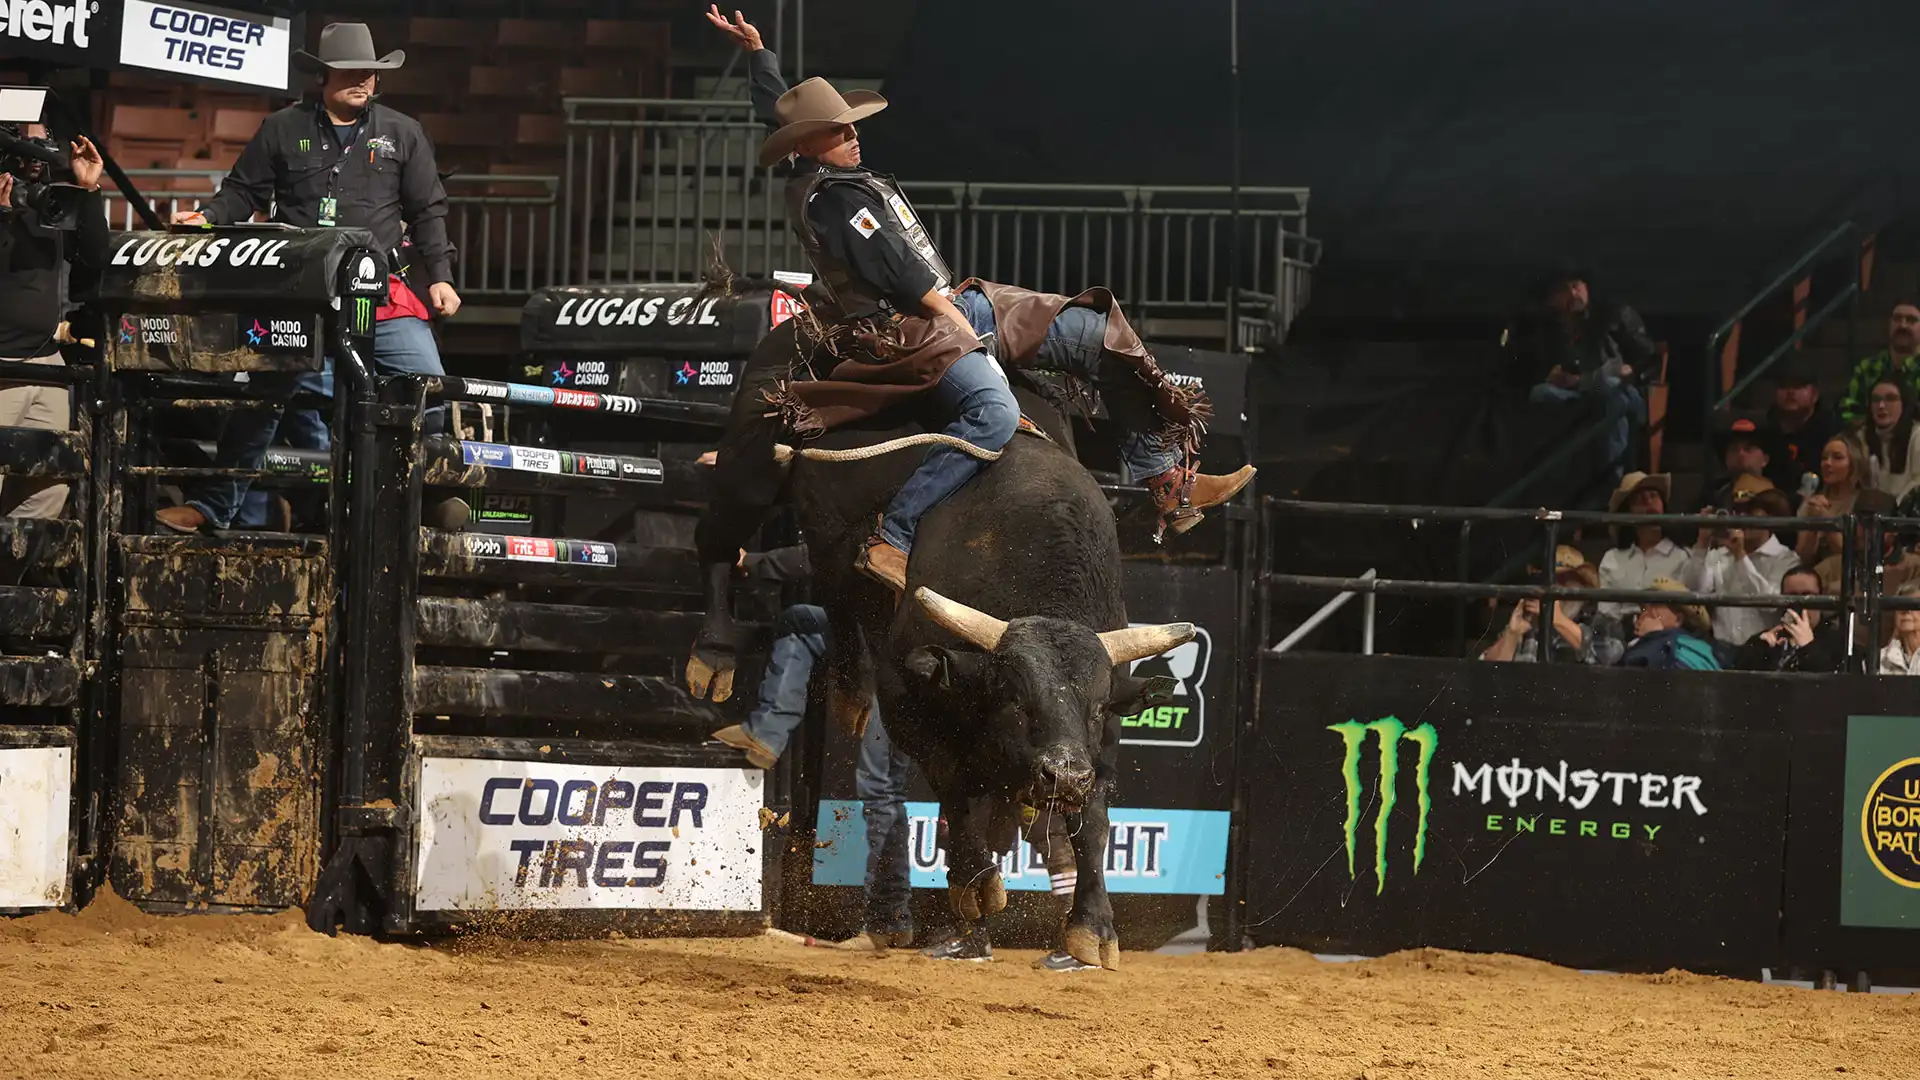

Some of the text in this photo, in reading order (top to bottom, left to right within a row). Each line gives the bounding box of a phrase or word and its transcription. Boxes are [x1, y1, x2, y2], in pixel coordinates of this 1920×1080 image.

[149, 7, 265, 47] COOPER
[164, 37, 246, 71] TIRES
[111, 238, 231, 267] LUCAS
[555, 297, 665, 326] LUCAS
[140, 318, 170, 331] MODO
[270, 320, 301, 334] MODO
[141, 331, 178, 344] CASINO
[271, 334, 308, 348] CASINO
[576, 361, 606, 373] MODO
[700, 361, 729, 373] MODO
[574, 373, 609, 386] CASINO
[698, 373, 733, 386] CASINO
[556, 392, 597, 407] LUCAS OIL
[601, 394, 637, 413] YETI
[515, 449, 554, 460] COOPER
[522, 459, 549, 470] TIRES
[463, 537, 501, 555] Kubota
[1119, 706, 1190, 729] EAST
[1452, 758, 1708, 815] MONSTER
[1904, 779, 1920, 800] U
[479, 777, 709, 828] COOPER
[1486, 815, 1662, 840] ENERGY
[1878, 831, 1920, 852] PAT
[510, 840, 672, 888] TIRES
